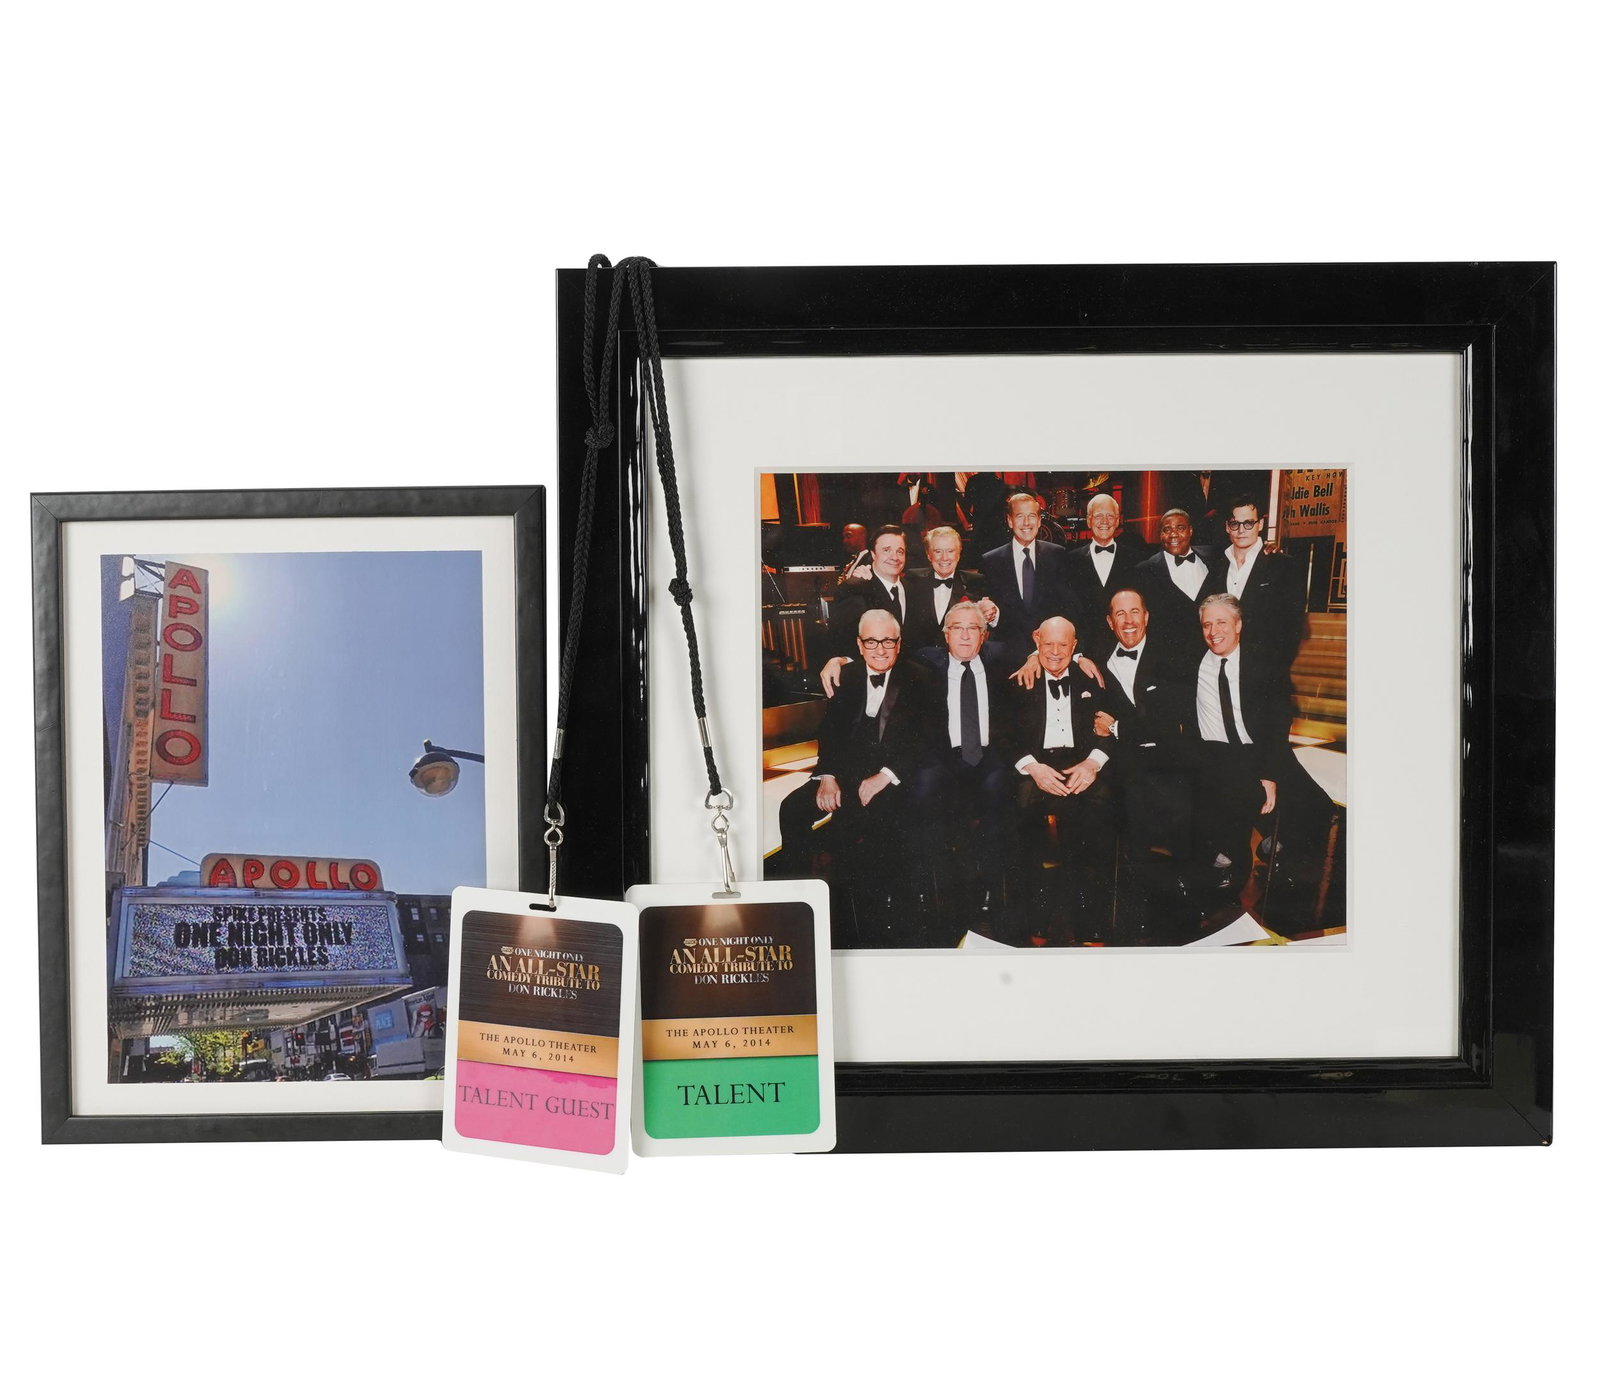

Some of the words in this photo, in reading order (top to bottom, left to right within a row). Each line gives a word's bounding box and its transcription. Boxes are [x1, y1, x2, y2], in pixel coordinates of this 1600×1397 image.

[1313, 483, 1333, 498] Bell
[1299, 502, 1330, 517] Wallis
[156, 568, 203, 766] APOLLO
[209, 858, 378, 891] APOLLO
[212, 906, 254, 922] SPIKE
[258, 906, 327, 922] PRESENTS
[174, 922, 222, 948] ONE
[227, 922, 296, 947] NIGHT
[303, 921, 352, 946] ONLY
[699, 937, 718, 946] ONE
[719, 937, 749, 946] NIGHT
[750, 936, 774, 945] ONLY
[214, 947, 250, 968] DON
[256, 947, 329, 966] RICKLES
[514, 948, 533, 957] ONE
[534, 949, 561, 959] NIGHT
[562, 952, 584, 962] ONLY
[670, 948, 696, 964] AN
[700, 945, 792, 964] ALL-STAR
[487, 955, 512, 971] AN
[515, 958, 600, 981] ALL-STAR
[669, 963, 719, 974] COMEDY
[722, 961, 774, 972] TRIBUTE
[776, 960, 793, 971] TO
[486, 970, 532, 984] COMEDY
[534, 975, 583, 989] TRIBUTE
[585, 980, 600, 991] TO
[694, 974, 718, 985] DON
[721, 973, 769, 984] RICKLES
[508, 983, 530, 995] DON
[533, 986, 578, 1000] RICKLES
[666, 1029, 688, 1037] THE
[692, 1027, 739, 1036] APOLLO
[741, 1025, 795, 1036] THEATER
[479, 1032, 500, 1043] THE
[503, 1035, 546, 1048] APOLLO
[548, 1040, 597, 1054] THEATER
[692, 1040, 718, 1049] MAY
[725, 1040, 736, 1049] 6,
[743, 1039, 771, 1047] 2014
[502, 1048, 526, 1058] MAY
[532, 1051, 542, 1061] 6,
[548, 1053, 575, 1063] 2014
[677, 1081, 786, 1106] TALENT
[459, 1085, 539, 1111] TALENT
[545, 1096, 615, 1120] GUEST
